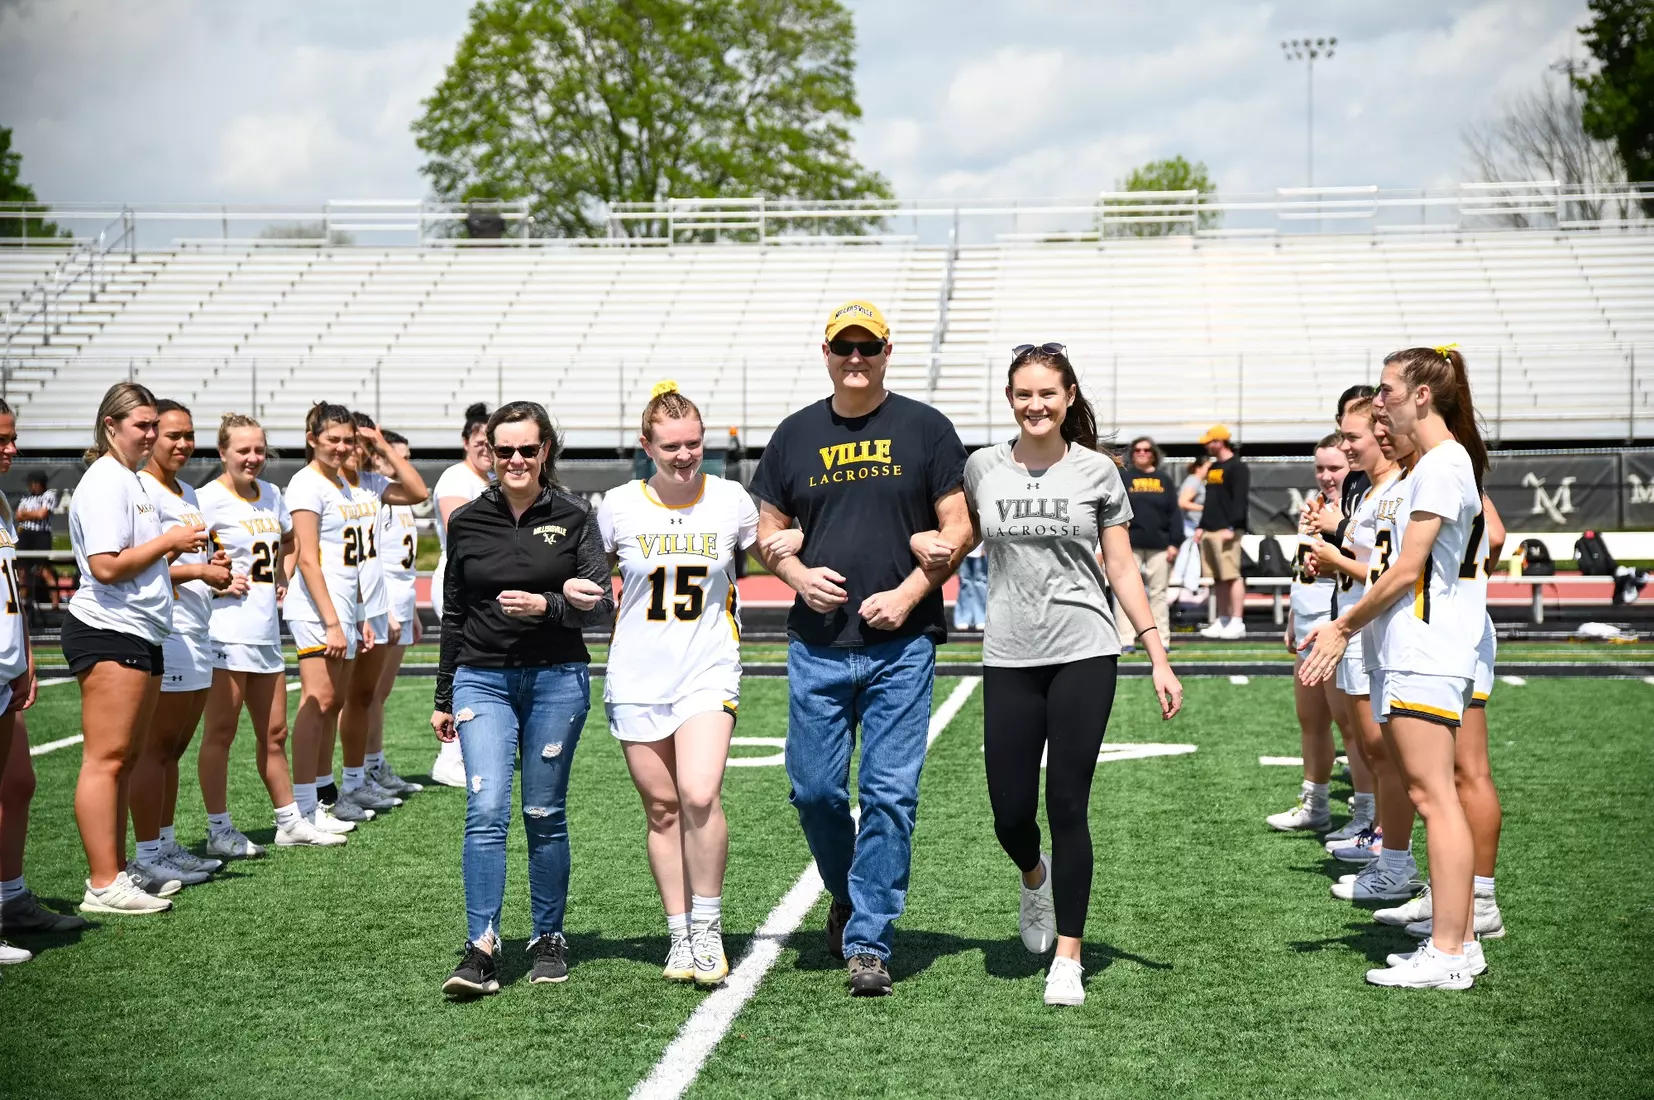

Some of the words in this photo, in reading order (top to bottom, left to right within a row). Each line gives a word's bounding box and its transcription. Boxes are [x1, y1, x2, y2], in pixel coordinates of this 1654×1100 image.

[819, 439, 892, 470] VILLE
[809, 465, 903, 487] LACROSSE
[995, 498, 1070, 524] VILLE
[986, 524, 1081, 538] LACROSSE
[637, 533, 718, 561] VILLE
[648, 565, 708, 622] 15
